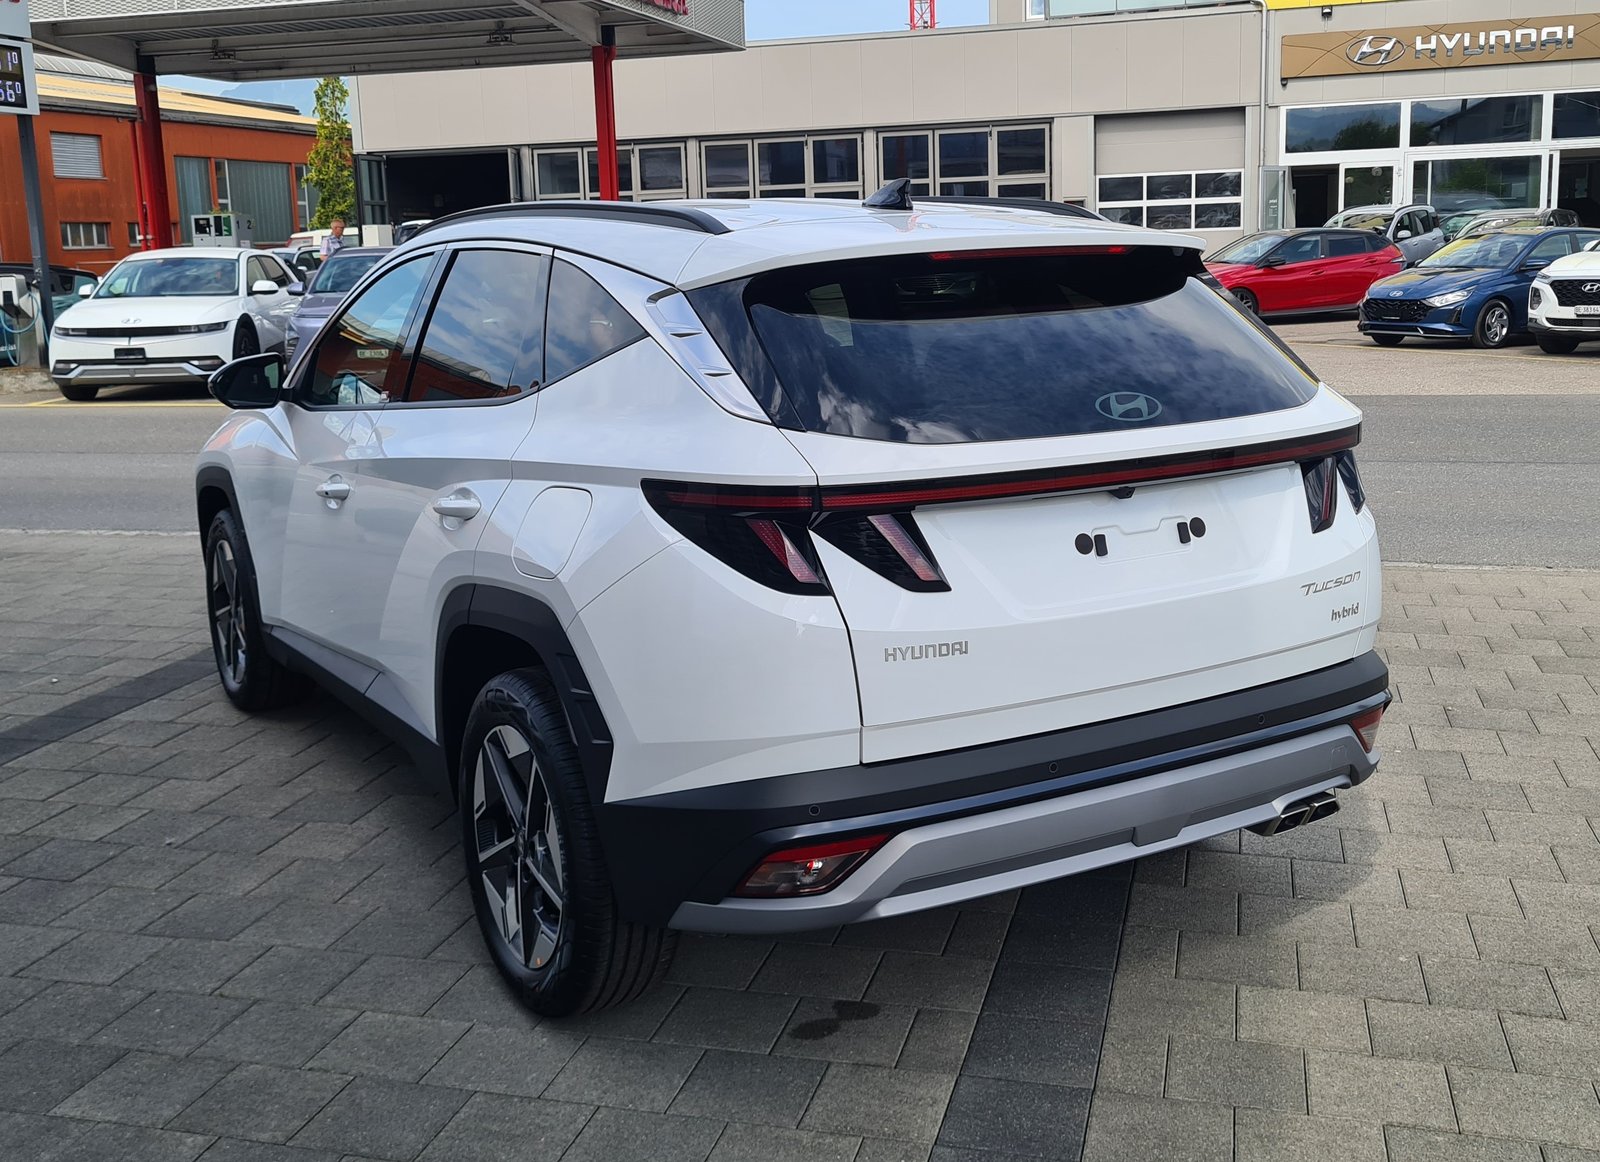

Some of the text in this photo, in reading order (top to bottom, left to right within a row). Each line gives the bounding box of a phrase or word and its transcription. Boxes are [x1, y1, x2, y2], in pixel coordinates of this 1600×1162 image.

[1415, 25, 1575, 59] HYUNDAI
[1331, 602, 1360, 624] hybrid
[884, 640, 969, 662] HYUNDAI
